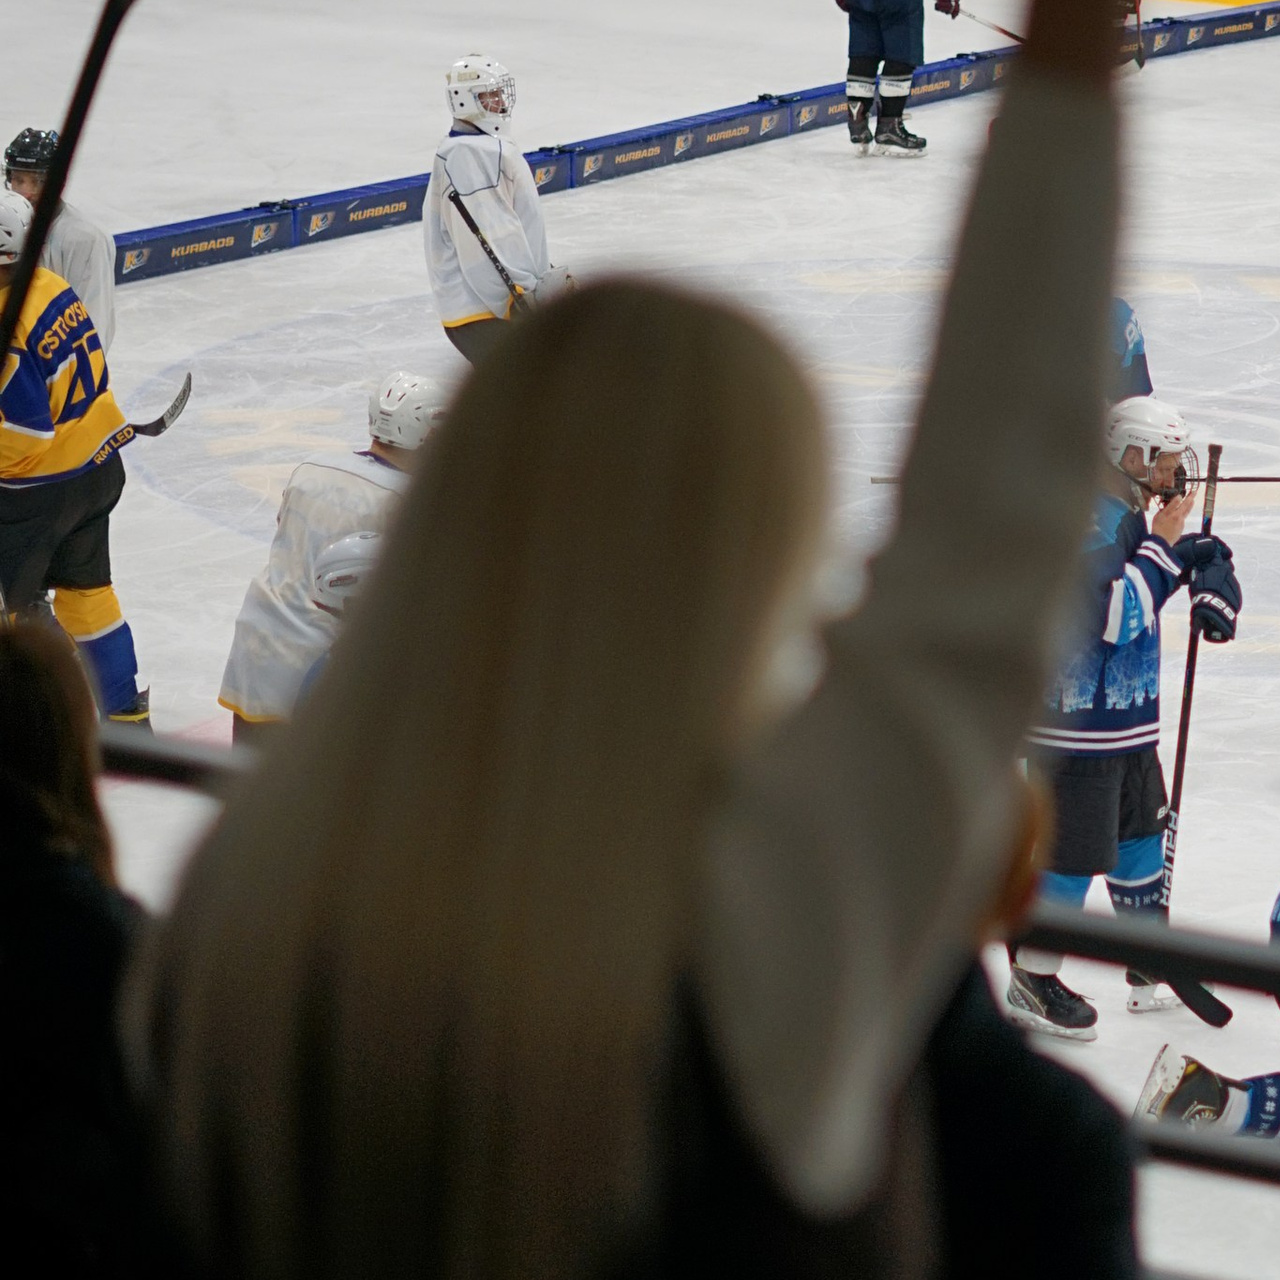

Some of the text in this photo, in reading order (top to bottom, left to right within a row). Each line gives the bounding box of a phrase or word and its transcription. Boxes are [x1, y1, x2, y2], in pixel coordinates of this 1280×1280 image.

[706, 124, 750, 143] KURBADS
[614, 146, 661, 165] KURBADS
[349, 201, 408, 222] KURBADS
[171, 235, 235, 258] KURBADS
